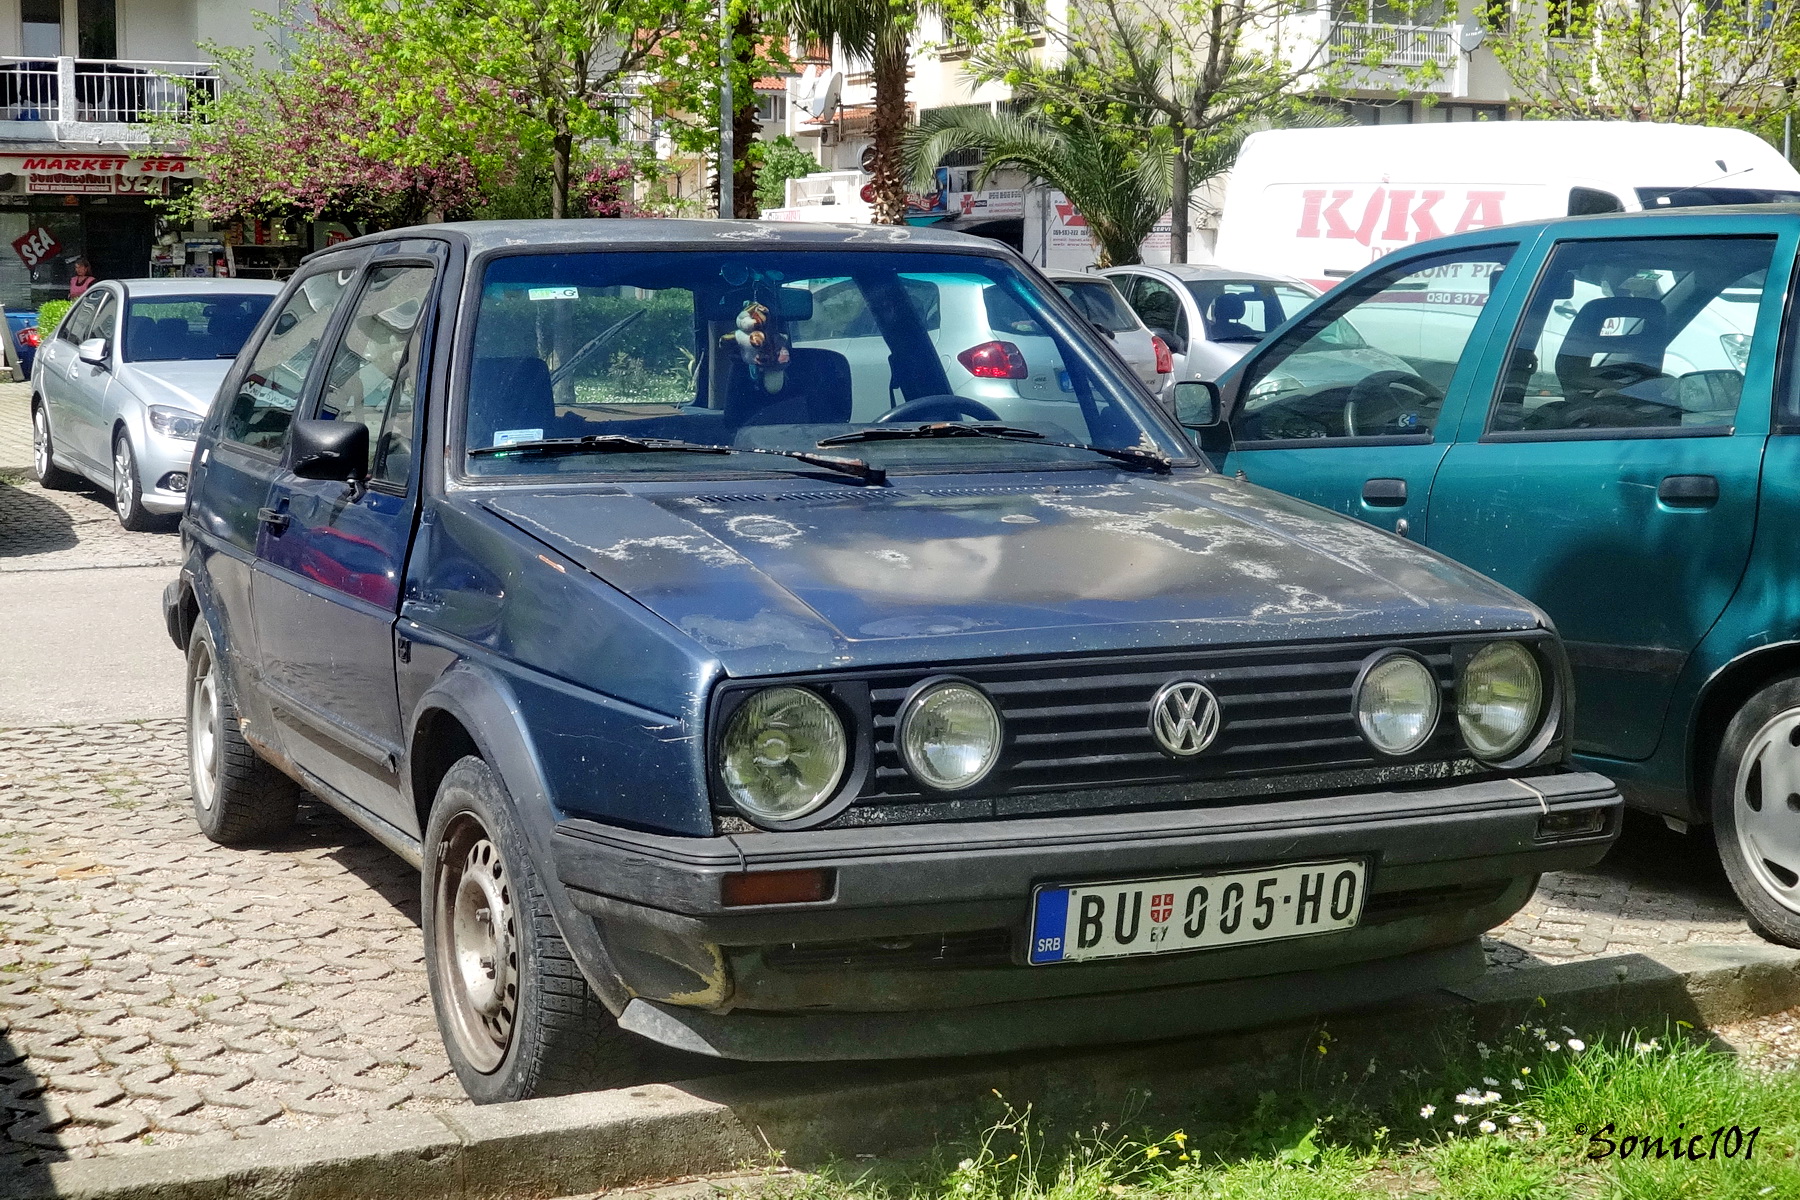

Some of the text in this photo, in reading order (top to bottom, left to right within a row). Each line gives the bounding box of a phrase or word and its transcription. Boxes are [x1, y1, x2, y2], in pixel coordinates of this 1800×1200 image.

[23, 159, 185, 172] MARKET SEA
[21, 227, 56, 265] SEA
[1427, 293, 1477, 304] 030 317
[1077, 870, 1357, 949] BU 005-HO
[1037, 937, 1061, 952] SRB
